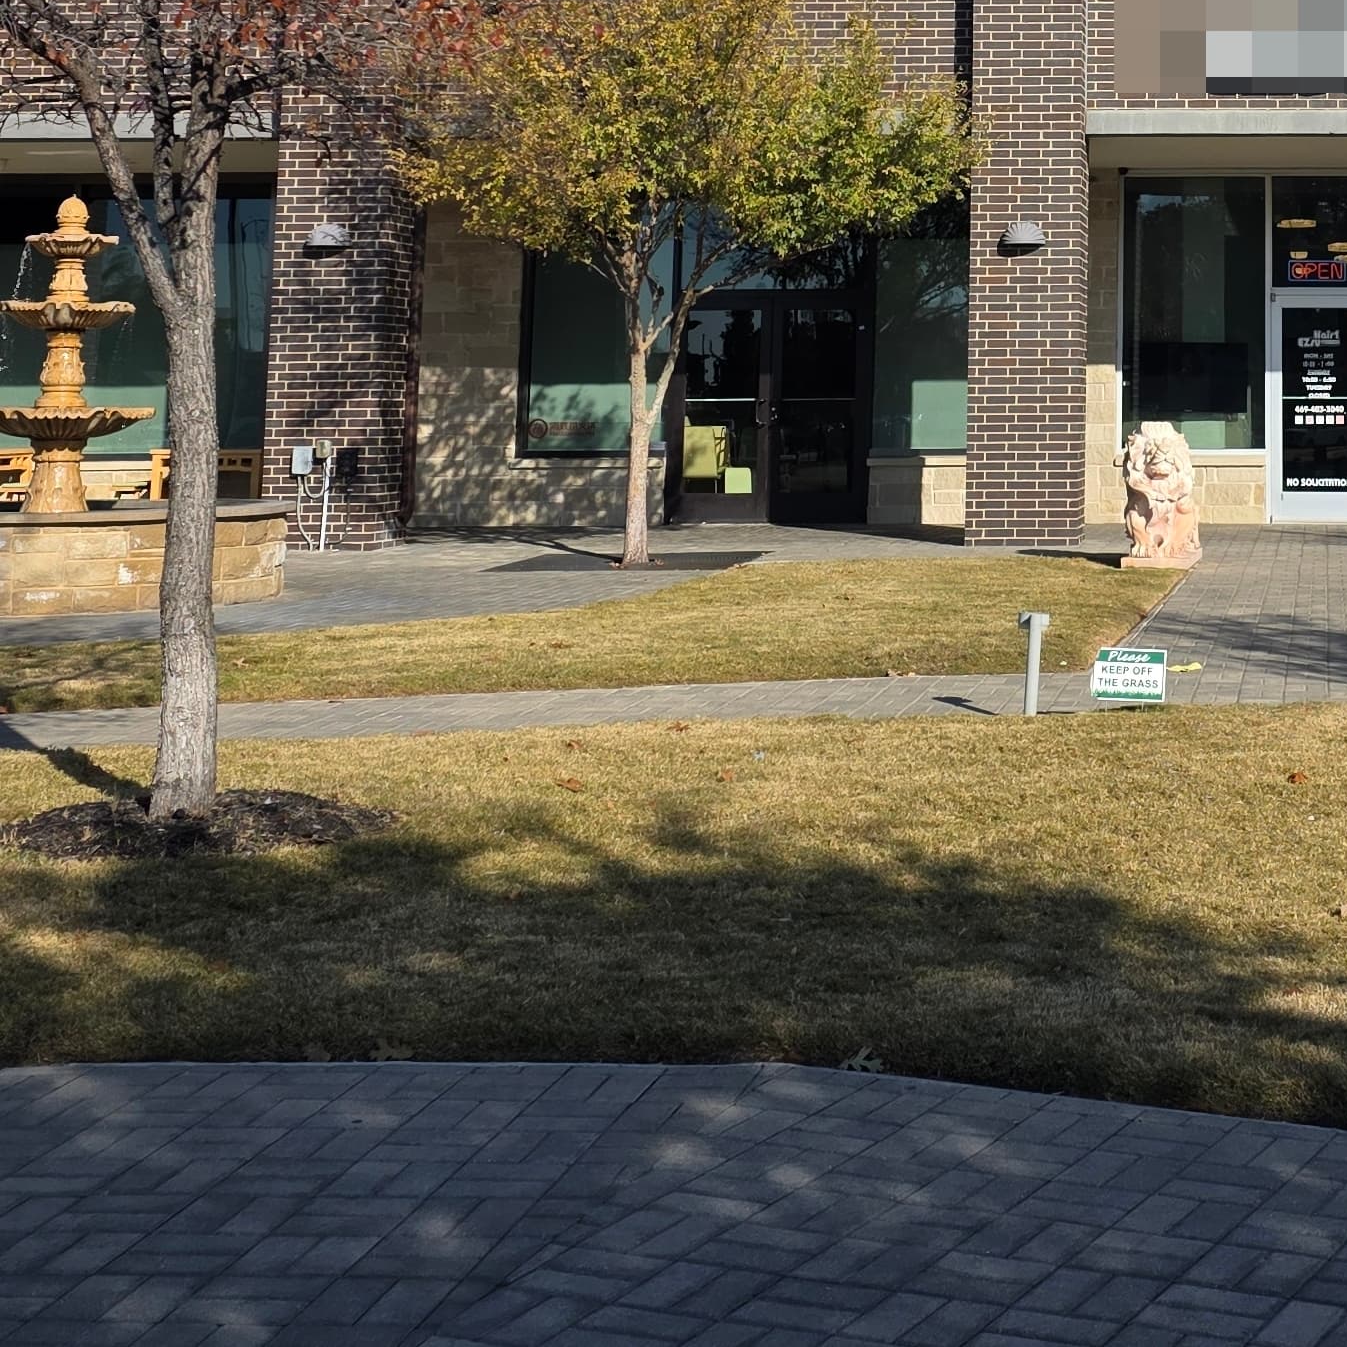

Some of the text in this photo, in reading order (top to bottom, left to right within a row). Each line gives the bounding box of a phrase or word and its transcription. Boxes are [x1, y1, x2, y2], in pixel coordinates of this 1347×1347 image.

[1291, 263, 1344, 280] OPEN
[1286, 477, 1300, 487] NO
[1107, 650, 1151, 663] Please
[1101, 665, 1153, 676] KEEP OFF
[1097, 677, 1159, 688] THE GRASS
